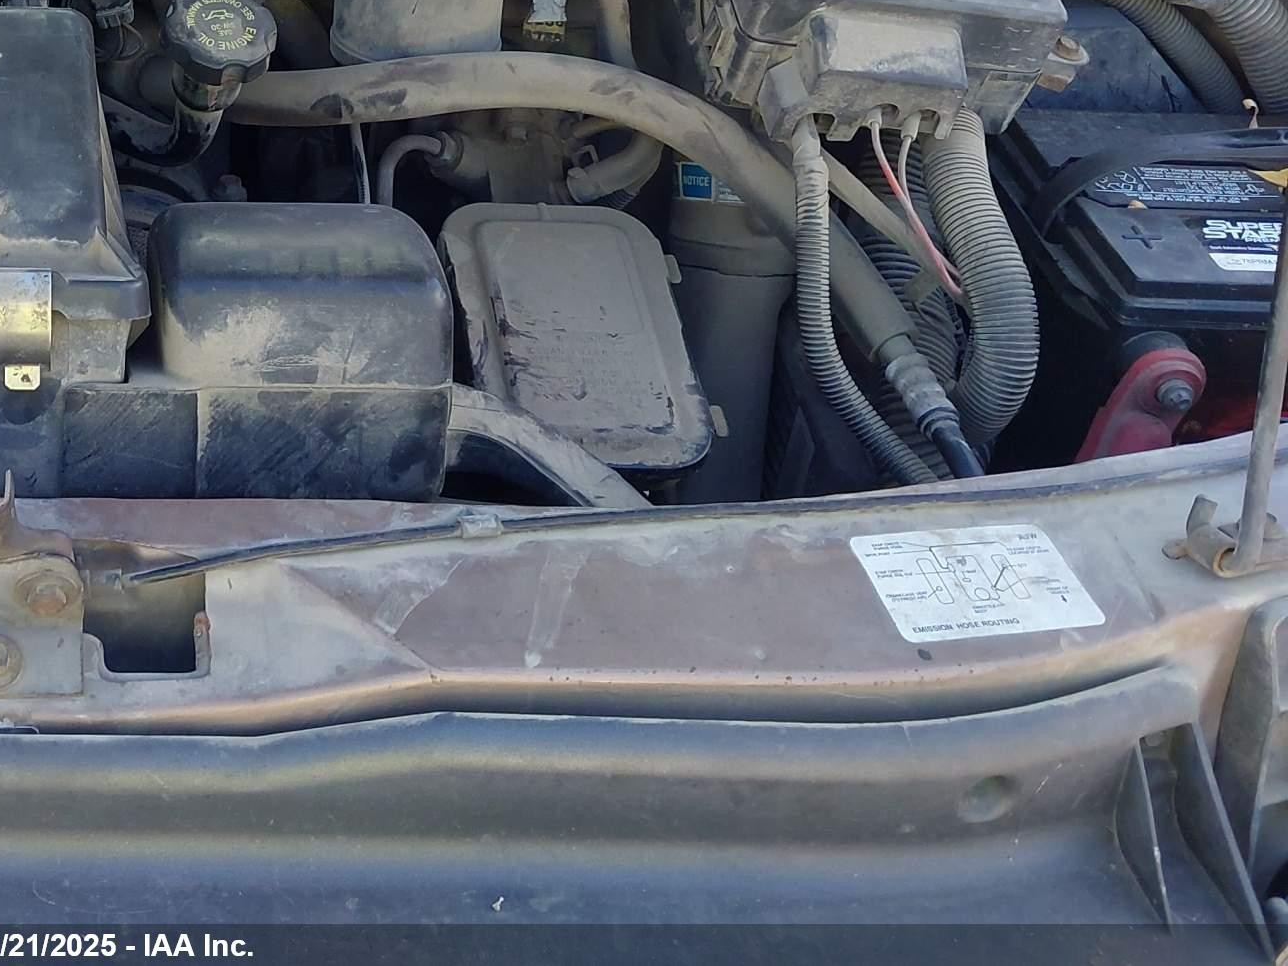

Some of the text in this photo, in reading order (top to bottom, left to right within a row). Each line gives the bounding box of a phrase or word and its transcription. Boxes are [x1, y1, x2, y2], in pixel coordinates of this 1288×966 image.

[240, 5, 255, 21] SEE
[198, 26, 257, 51] ENGINE OIL
[683, 175, 710, 187] NOTICE
[1202, 227, 1281, 240] STAR
[912, 618, 1020, 634] EMISSION HOSE ROUTING
